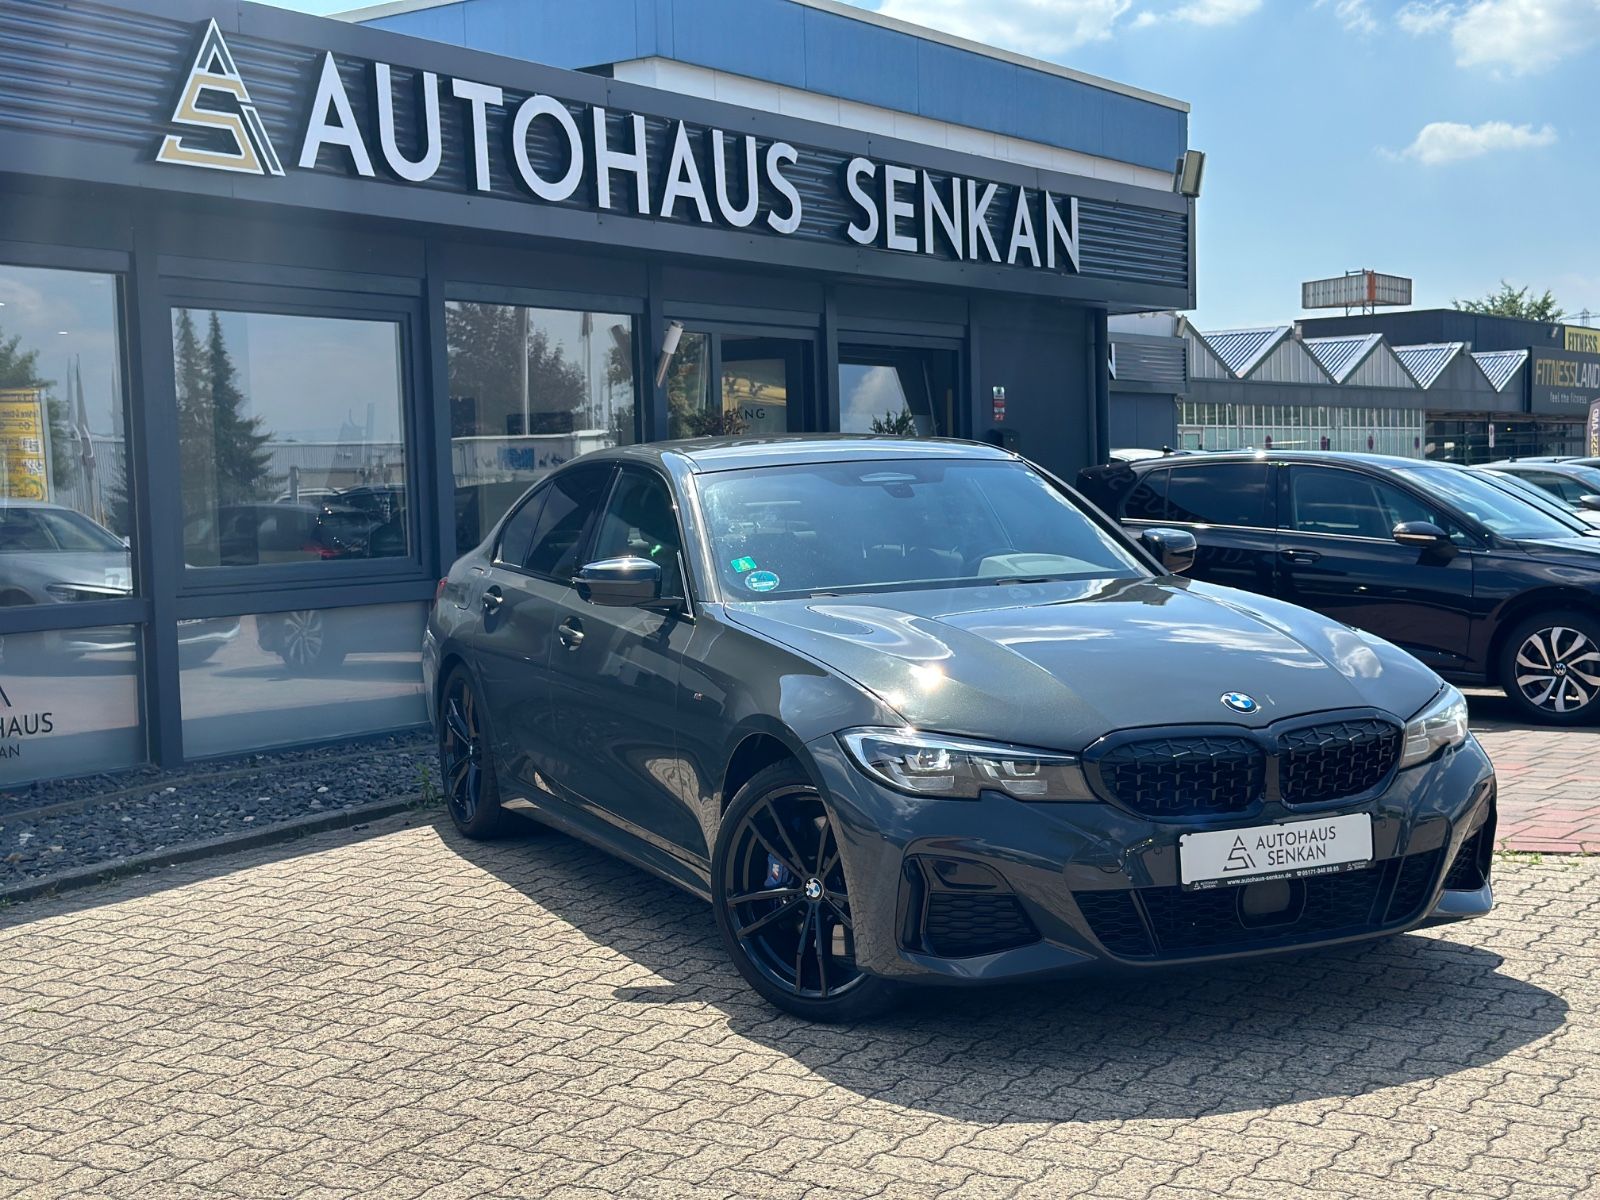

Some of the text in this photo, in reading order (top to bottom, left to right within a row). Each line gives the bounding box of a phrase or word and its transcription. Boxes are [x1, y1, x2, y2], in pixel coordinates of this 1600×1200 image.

[299, 50, 1080, 273] AUTOHAUS SENKAN
[1568, 332, 1598, 353] FITNESS
[1535, 359, 1600, 389] FITNESSLAND
[1256, 826, 1336, 850] AUTOHAUS
[1267, 843, 1326, 866] SENKAN
